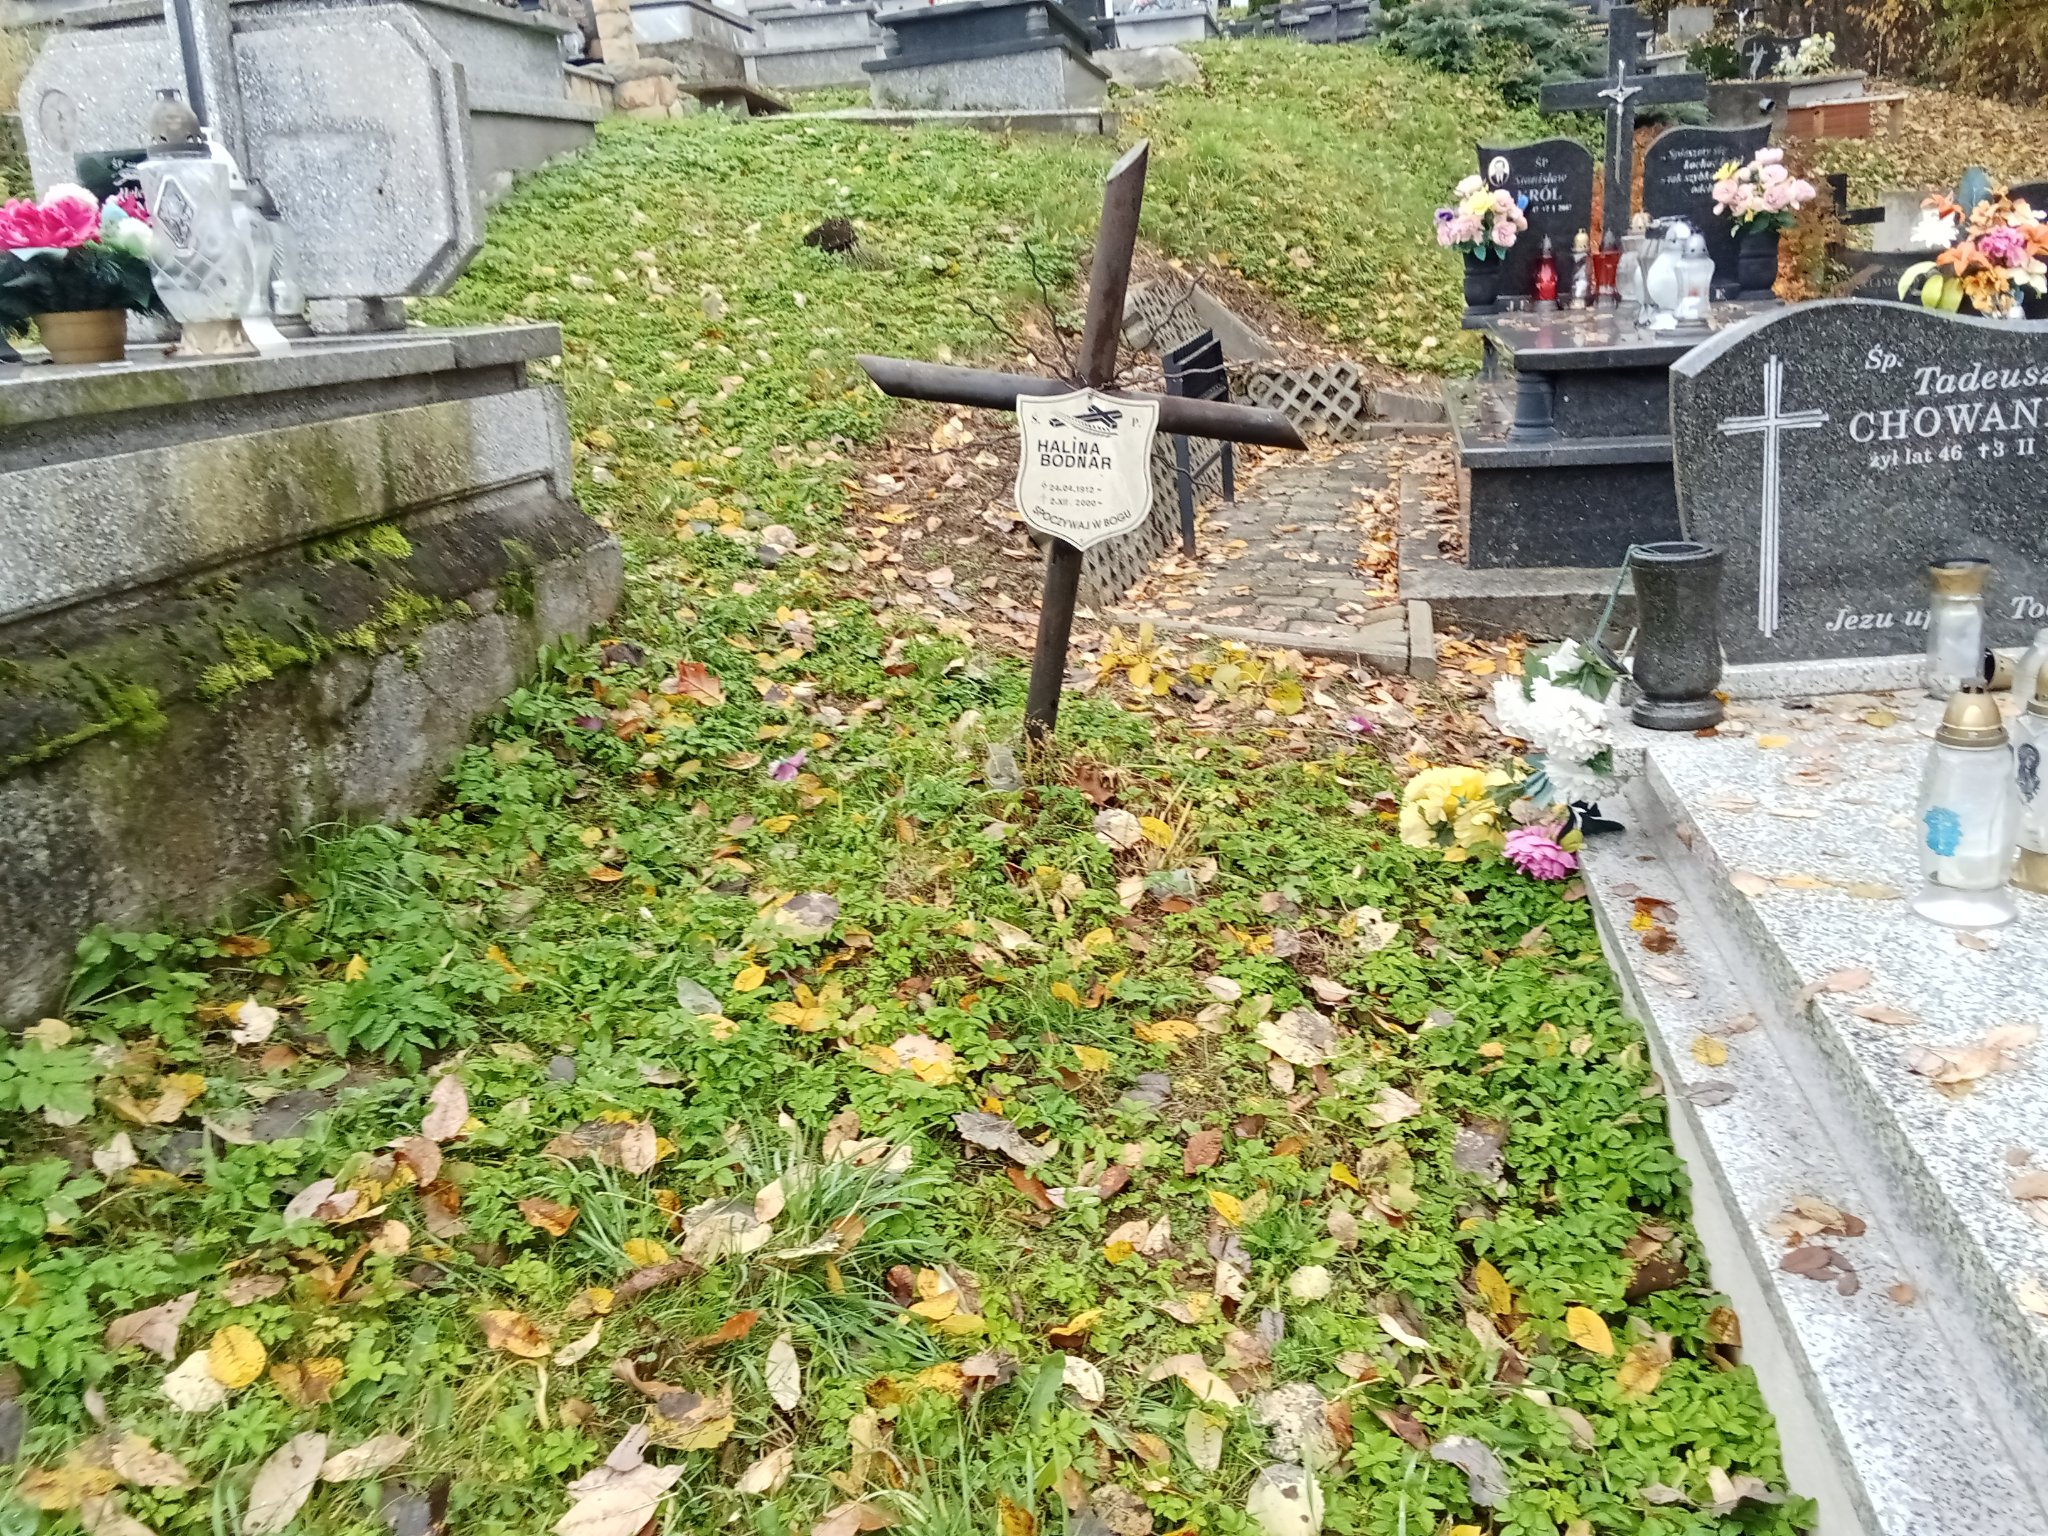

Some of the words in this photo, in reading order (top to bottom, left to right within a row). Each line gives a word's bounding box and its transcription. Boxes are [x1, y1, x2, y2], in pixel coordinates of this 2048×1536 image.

[1849, 397, 2048, 443] CHOWAN
[1040, 453, 1112, 471] BODNAR
[1904, 447, 1934, 464] lat
[1938, 444, 1963, 462] 46
[1032, 505, 1090, 530] SPOCZYWAJ
[1092, 519, 1101, 529] W
[1103, 508, 1132, 528] BOGU
[1825, 608, 1895, 632] Jezu
[2009, 595, 2048, 619] To
